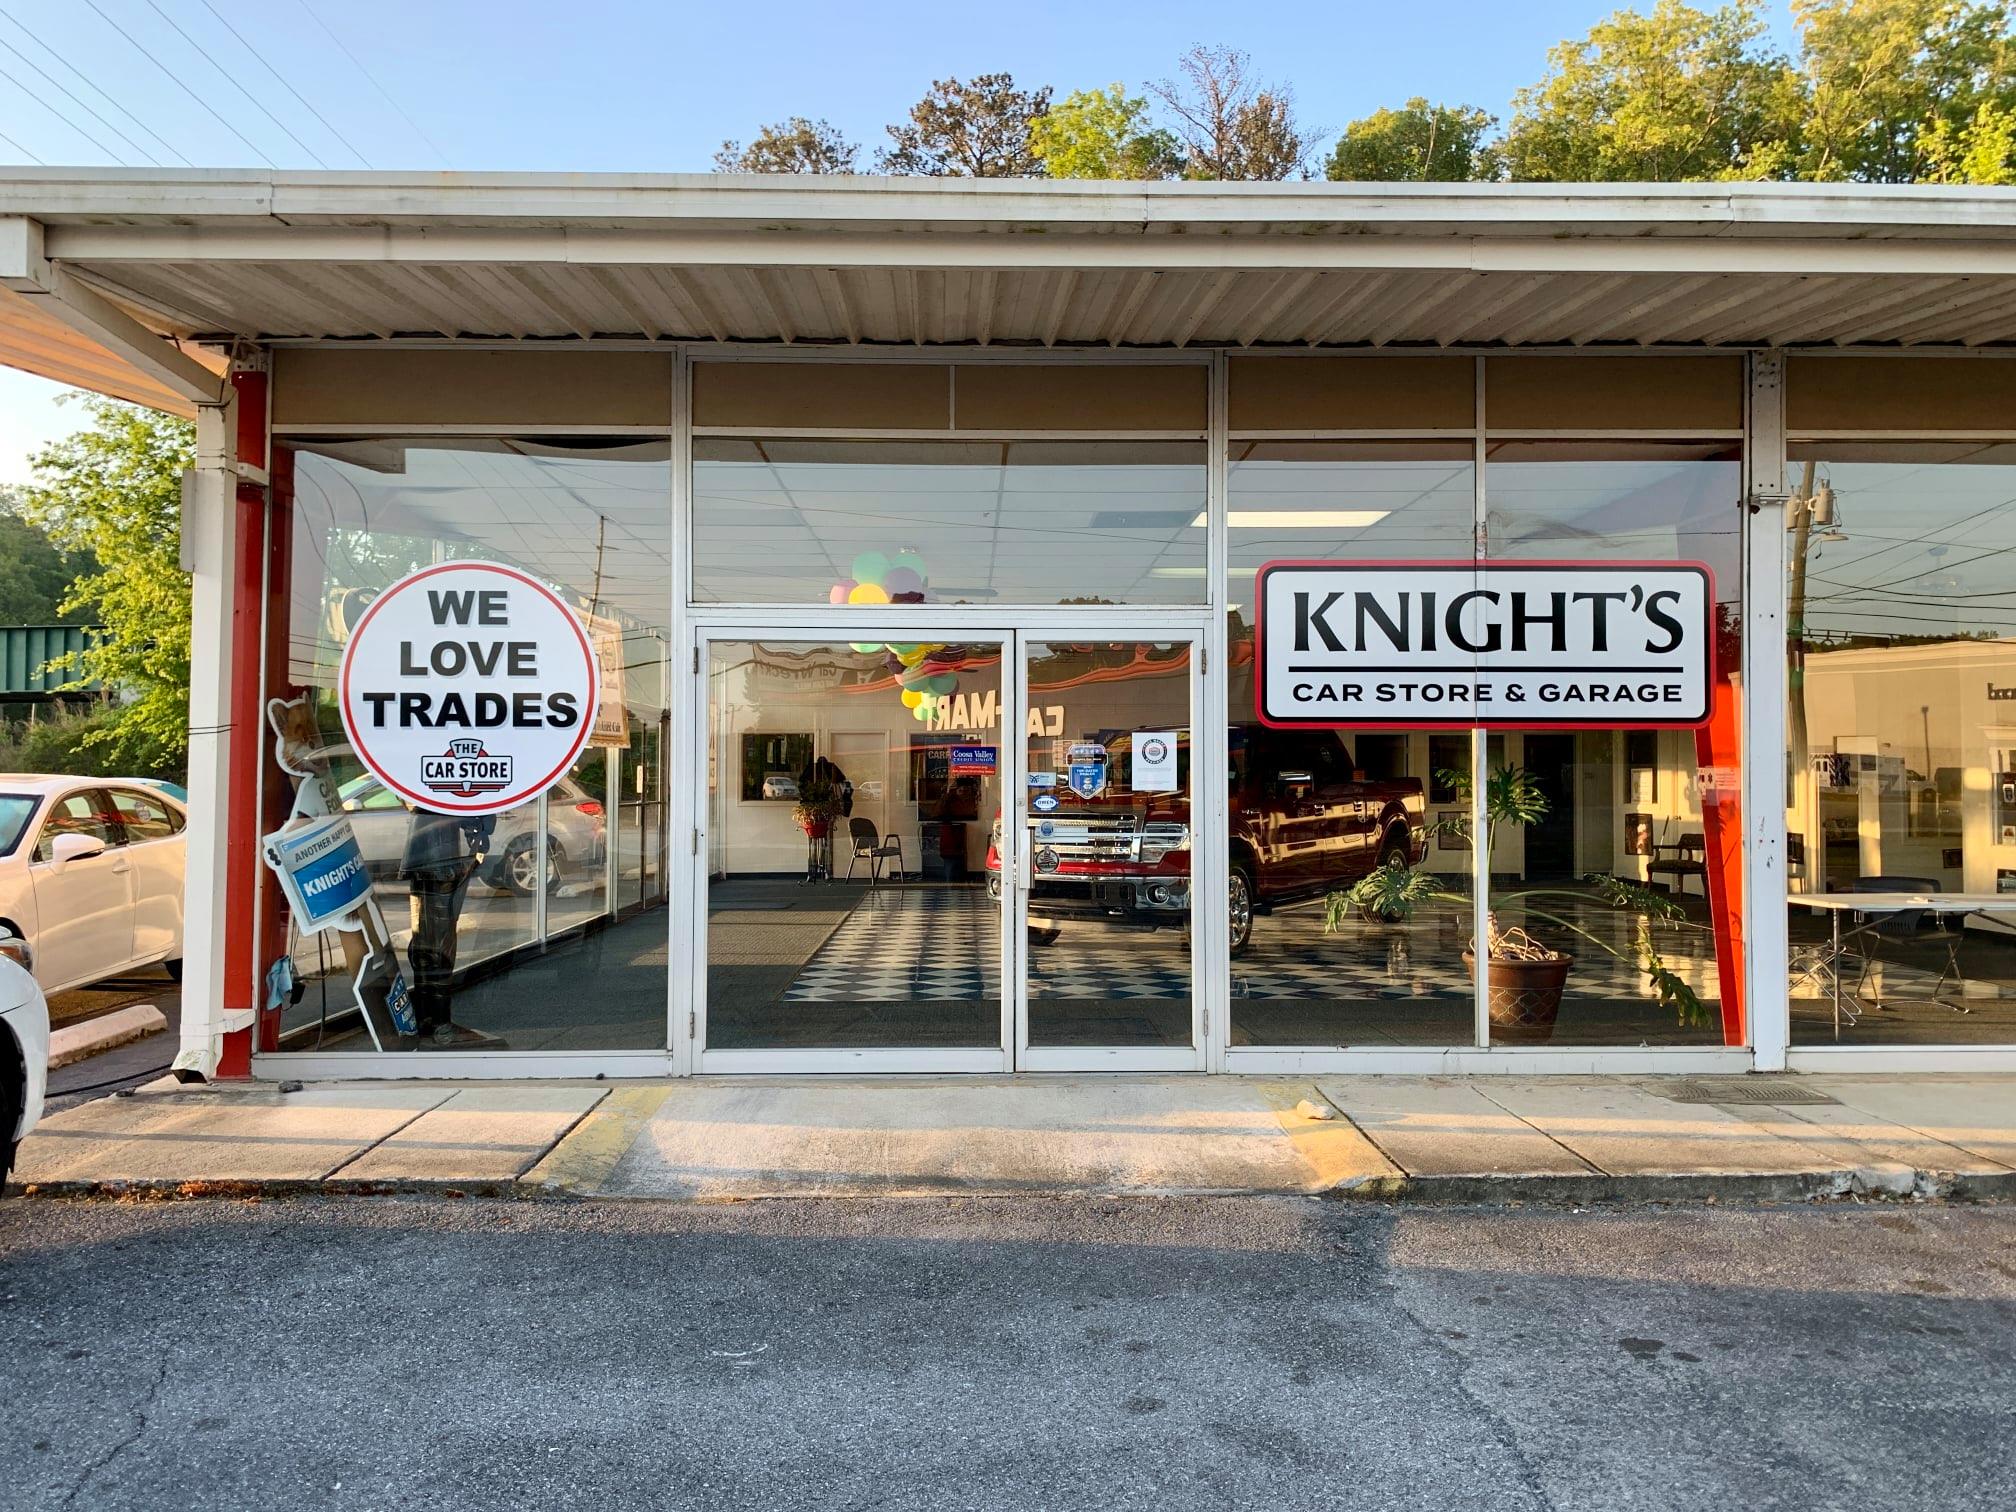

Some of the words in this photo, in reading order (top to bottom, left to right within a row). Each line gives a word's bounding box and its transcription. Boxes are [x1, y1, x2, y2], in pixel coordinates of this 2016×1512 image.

[427, 590, 508, 625] WE
[1293, 584, 1684, 654] KNIGHT'S
[400, 641, 538, 677] LOVE
[1292, 684, 1364, 702] CAR
[1375, 684, 1493, 702] STORE
[1505, 684, 1527, 702] &
[1538, 684, 1683, 702] GARAGE
[362, 692, 578, 728] TRADES
[454, 743, 478, 754] THE
[974, 750, 994, 759] Valley
[425, 762, 454, 778] CAR
[458, 762, 508, 778] STORE
[295, 836, 332, 862] ANOTHER
[303, 862, 356, 897] KNIGHT'S
